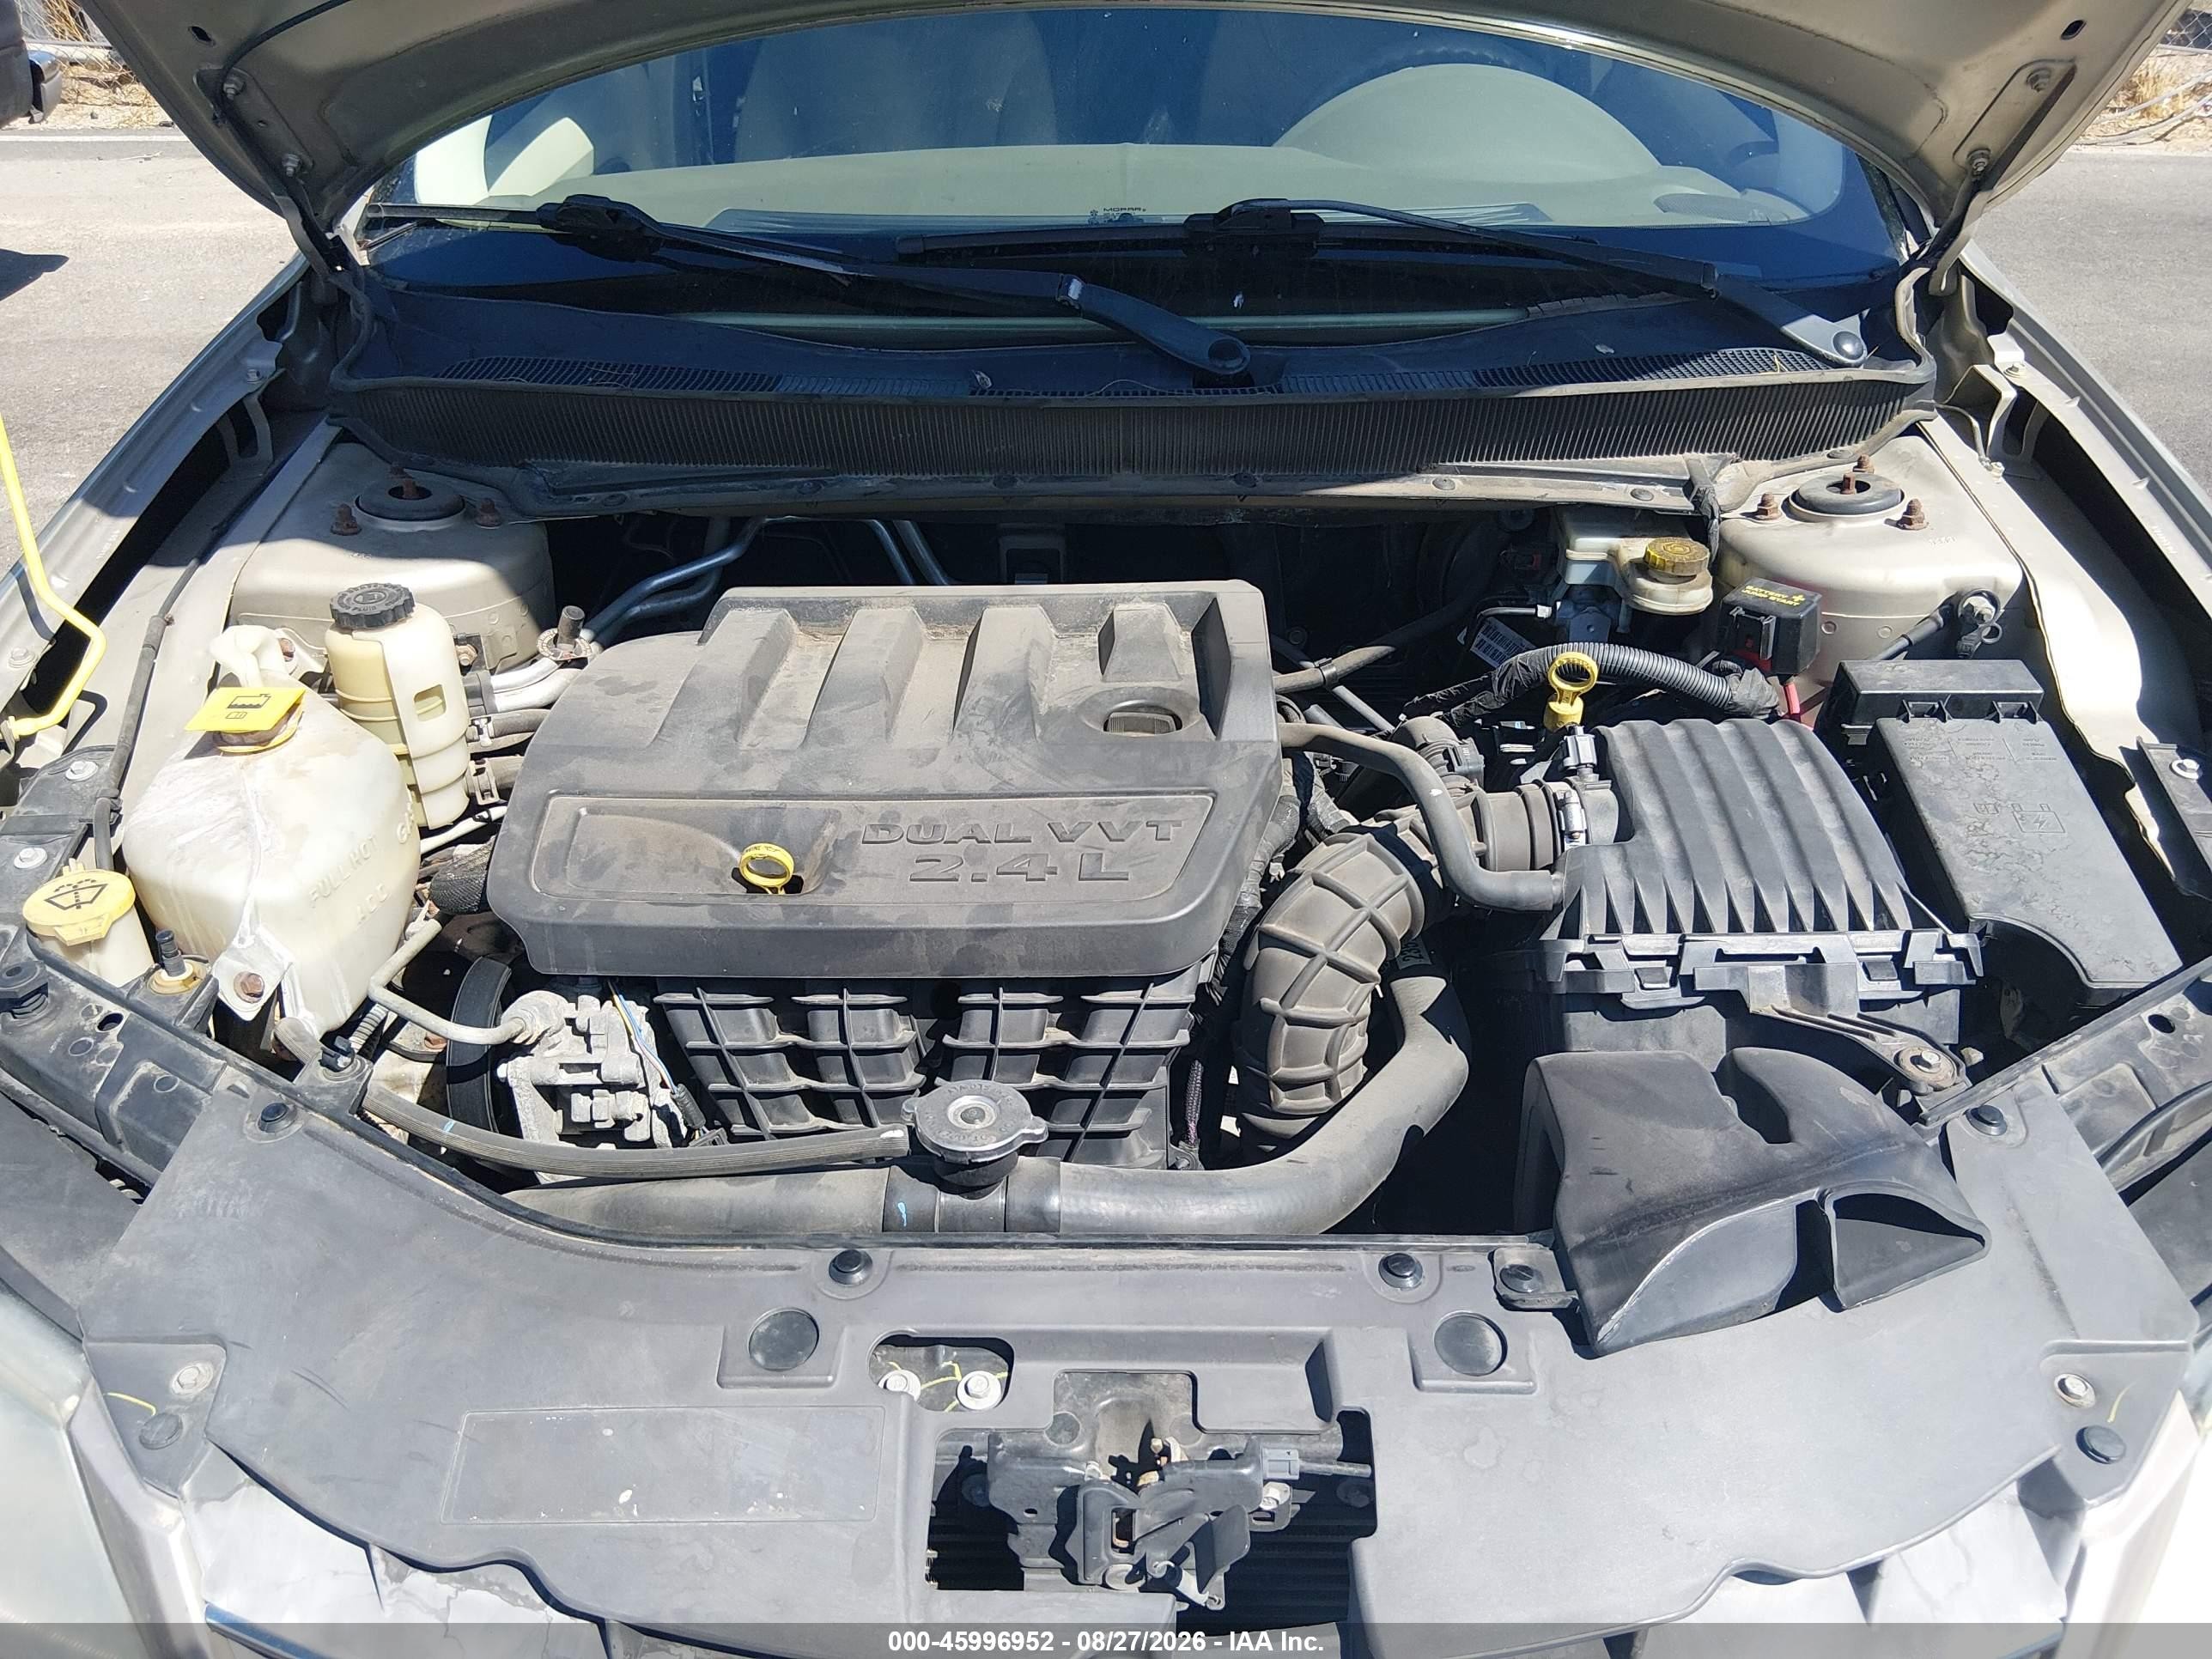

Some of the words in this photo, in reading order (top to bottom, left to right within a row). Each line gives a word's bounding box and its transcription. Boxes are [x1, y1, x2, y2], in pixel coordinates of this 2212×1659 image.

[1745, 585, 1789, 599] BATTERY
[1769, 595, 1801, 606] START
[861, 823, 1032, 845] DUAL
[1047, 820, 1183, 843] VVT
